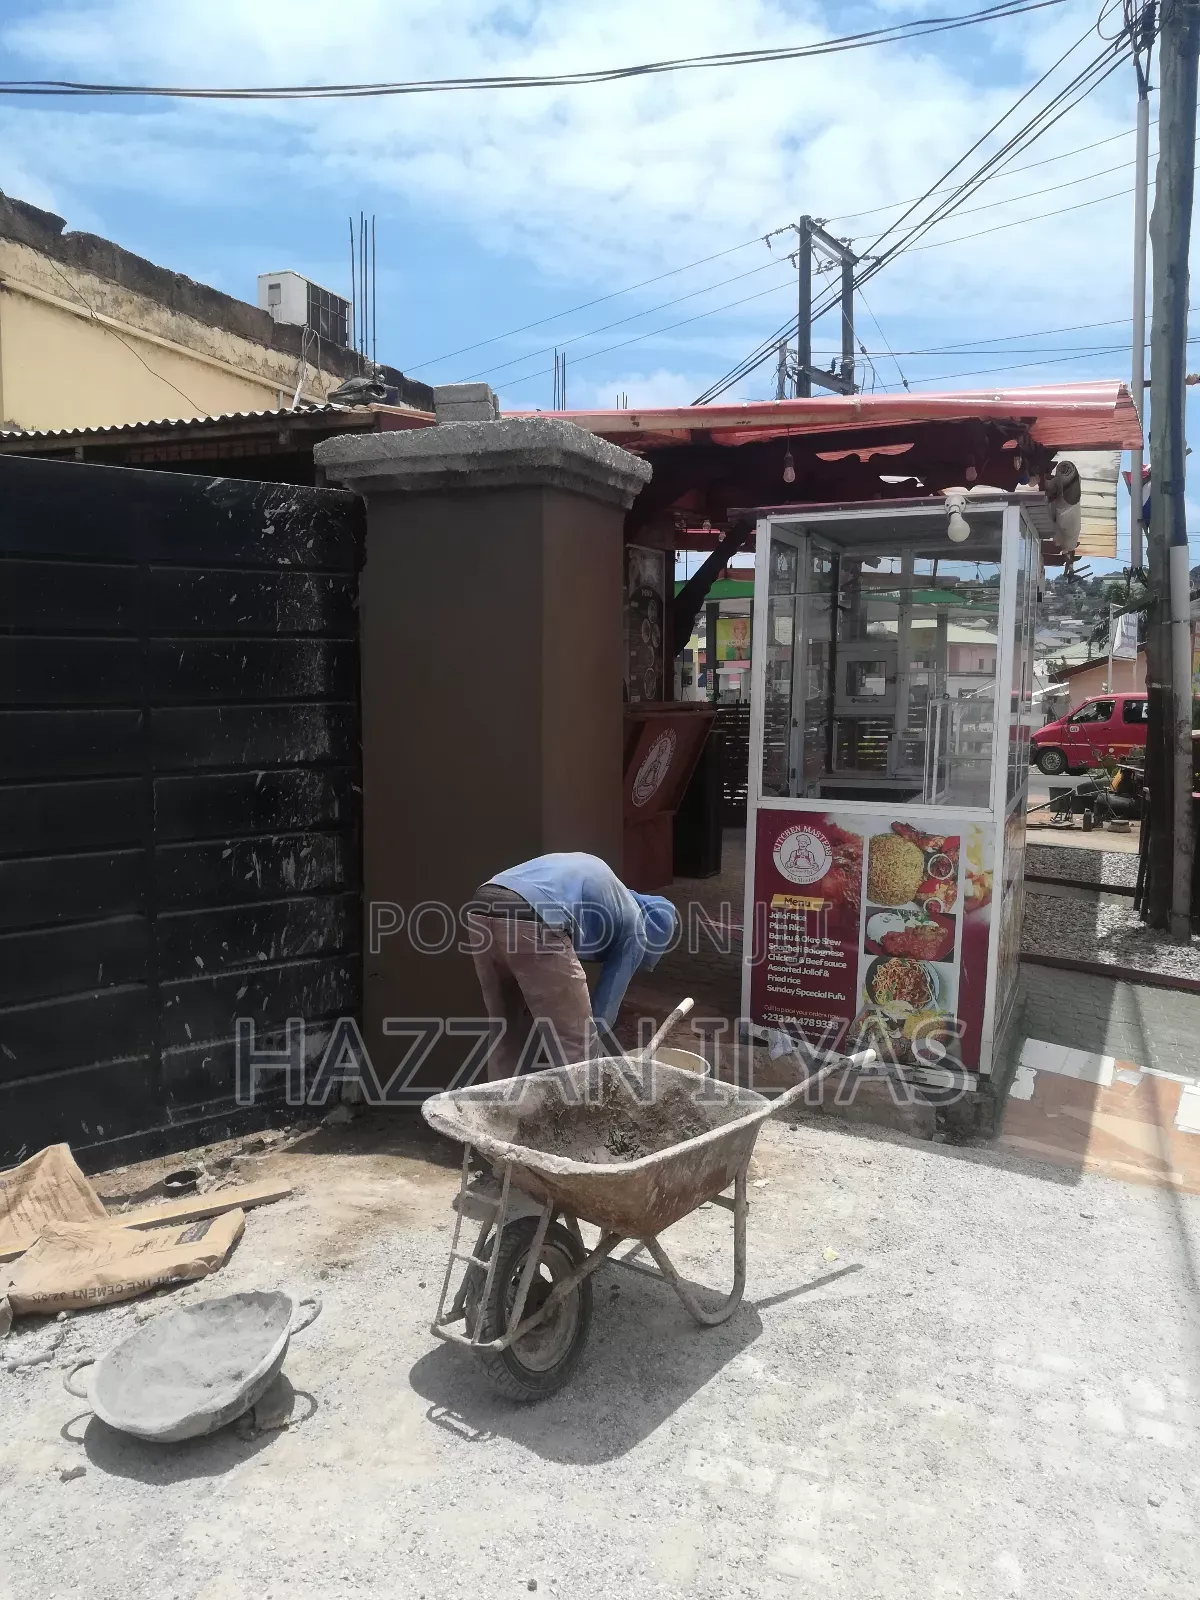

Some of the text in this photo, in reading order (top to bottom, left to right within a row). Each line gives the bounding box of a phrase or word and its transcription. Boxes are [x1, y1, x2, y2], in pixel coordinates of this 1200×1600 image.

[773, 826, 801, 851] KITCHEN
[784, 896, 811, 908] Menu
[769, 911, 807, 921] Jollof Rice
[769, 922, 806, 931] Plain Rice
[768, 932, 794, 941] Banku
[801, 935, 821, 943] Okro
[821, 937, 842, 946] Stew
[767, 953, 798, 963] Chicken
[805, 957, 824, 966] Beef
[823, 960, 848, 968] sauce
[767, 964, 802, 974] Assorted
[801, 967, 824, 976] Jollof
[767, 974, 802, 984] Fried rice
[766, 984, 796, 996] Sunday
[827, 992, 846, 1001] Fufu
[761, 1013, 785, 1023] +233
[783, 1015, 798, 1024] 24
[797, 1017, 816, 1027] 478
[70, 1282, 124, 1300] CEMENT
